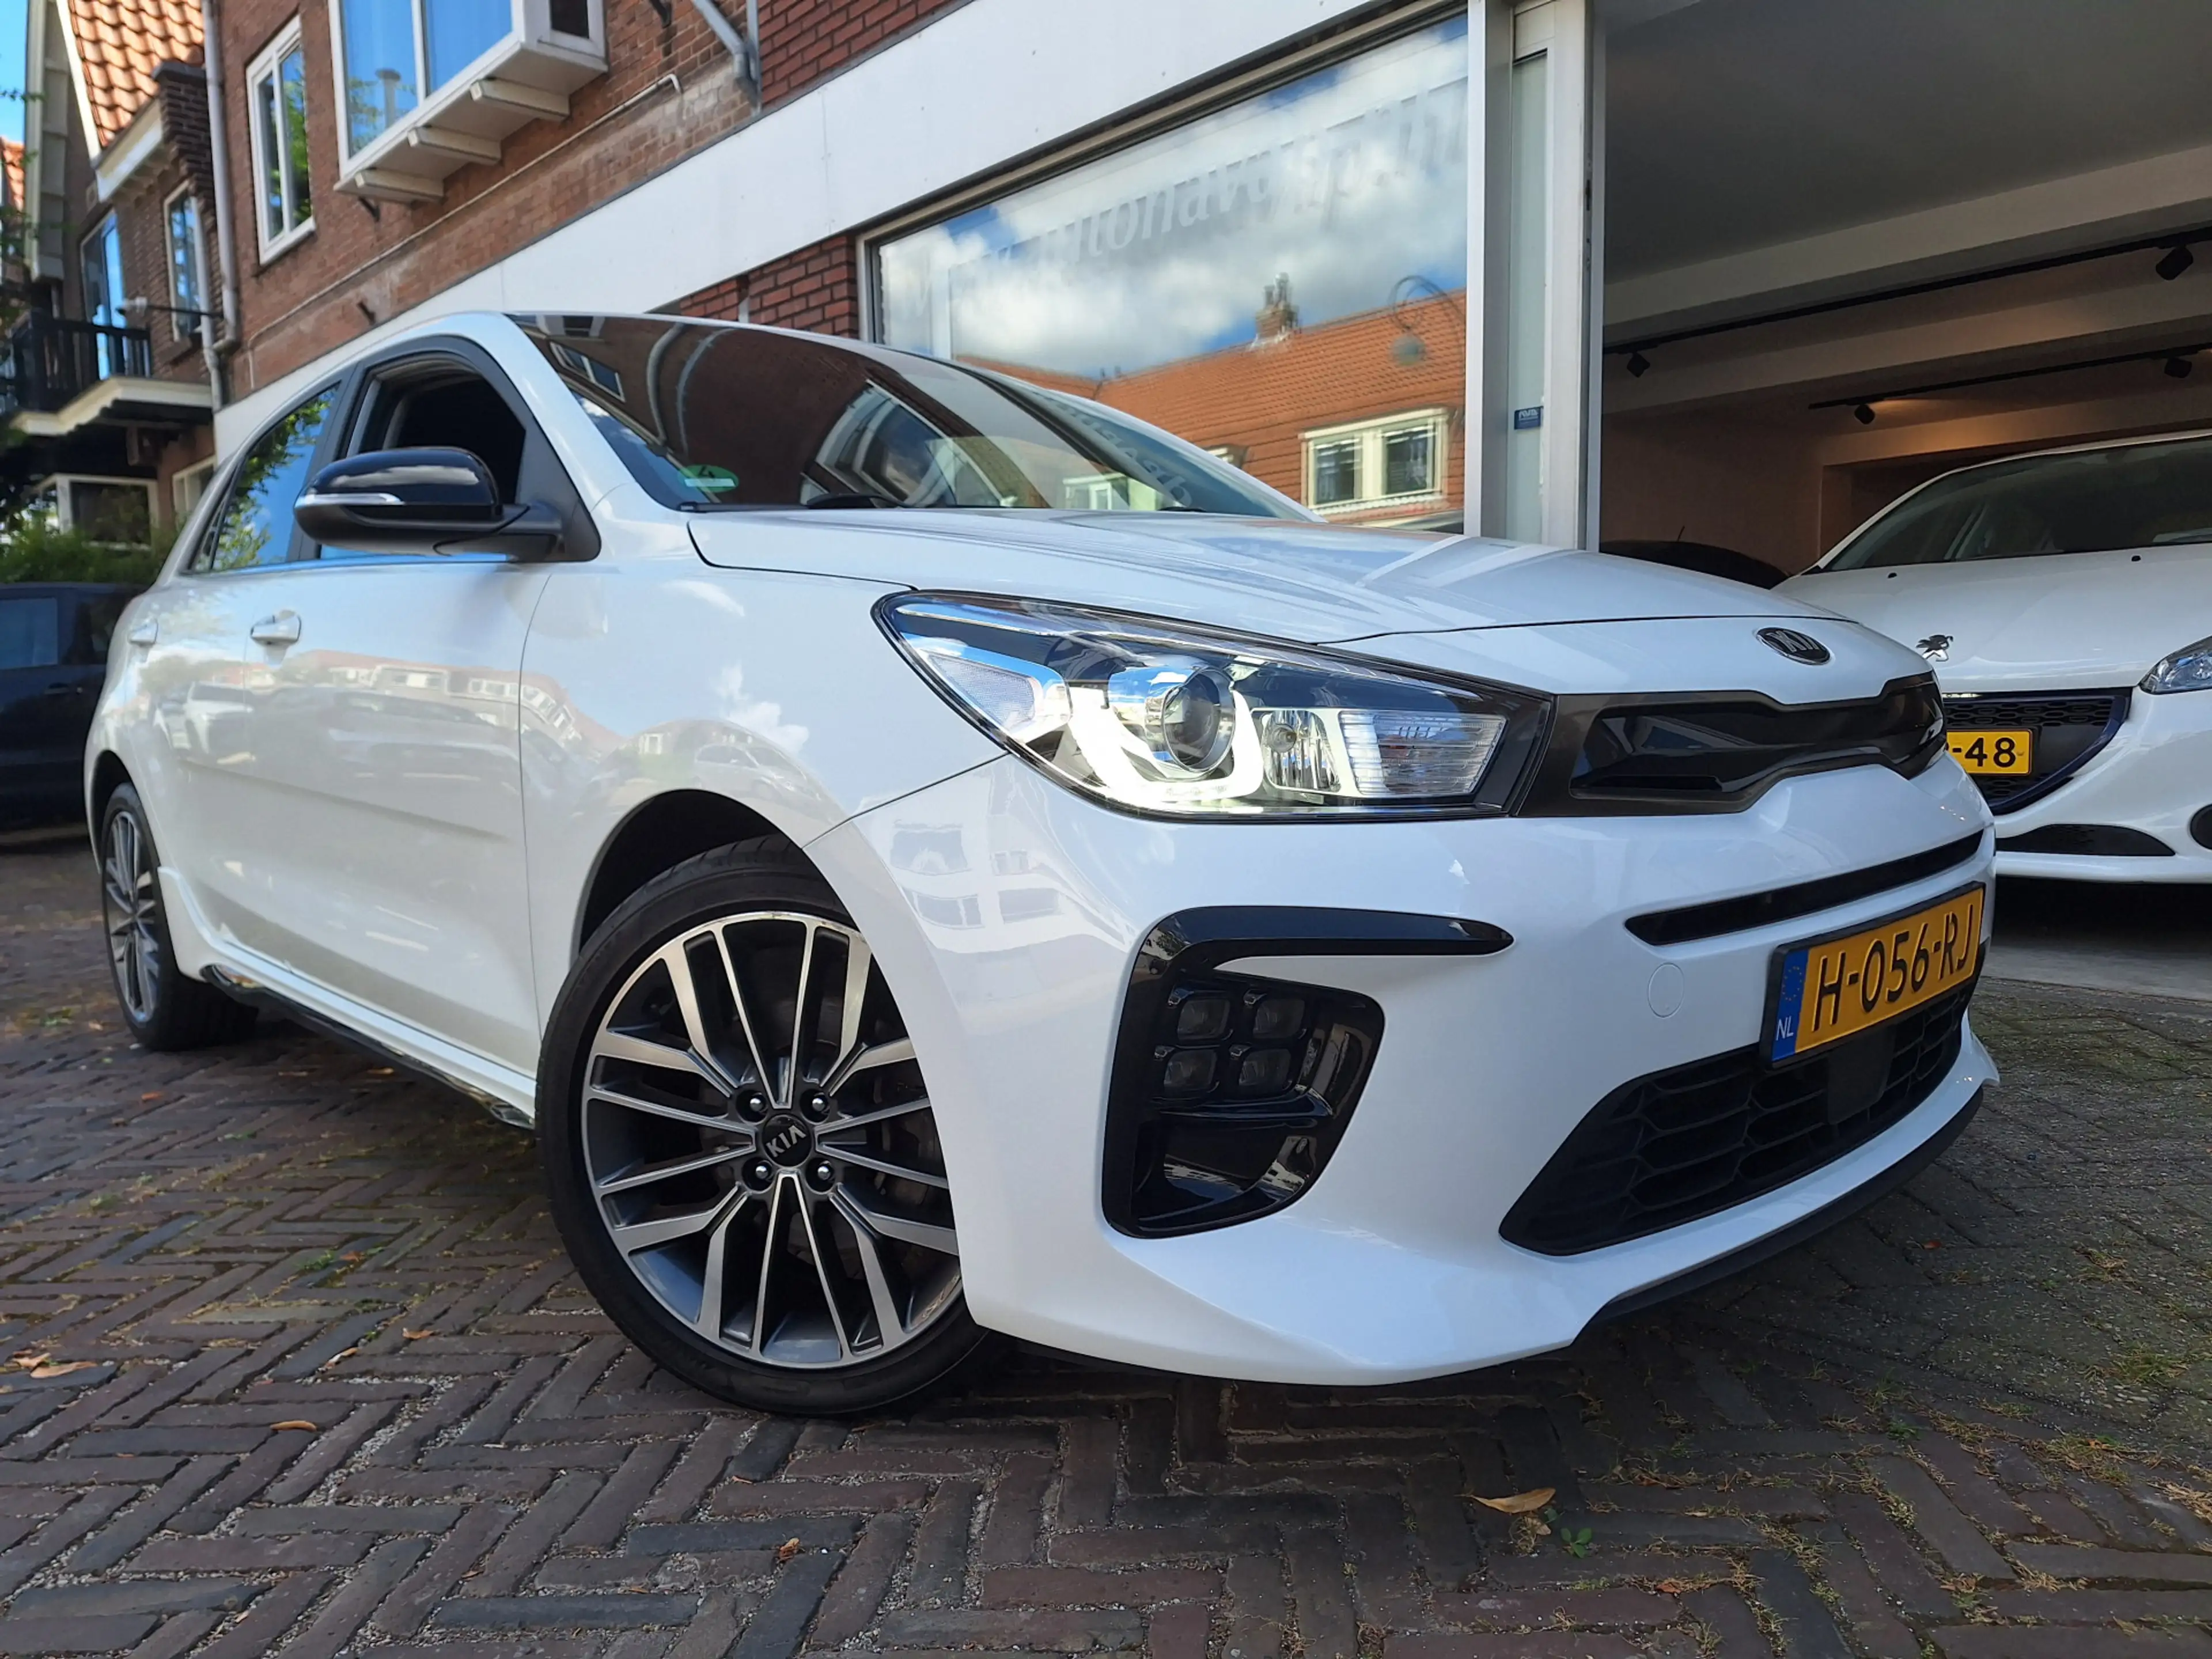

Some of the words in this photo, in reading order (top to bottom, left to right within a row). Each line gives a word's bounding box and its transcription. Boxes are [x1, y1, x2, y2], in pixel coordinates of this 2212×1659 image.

[1946, 737, 2016, 767] -48
[1812, 904, 1974, 1032] H-056-RJ
[1776, 1016, 1793, 1040] NL
[766, 1125, 806, 1157] KIA
